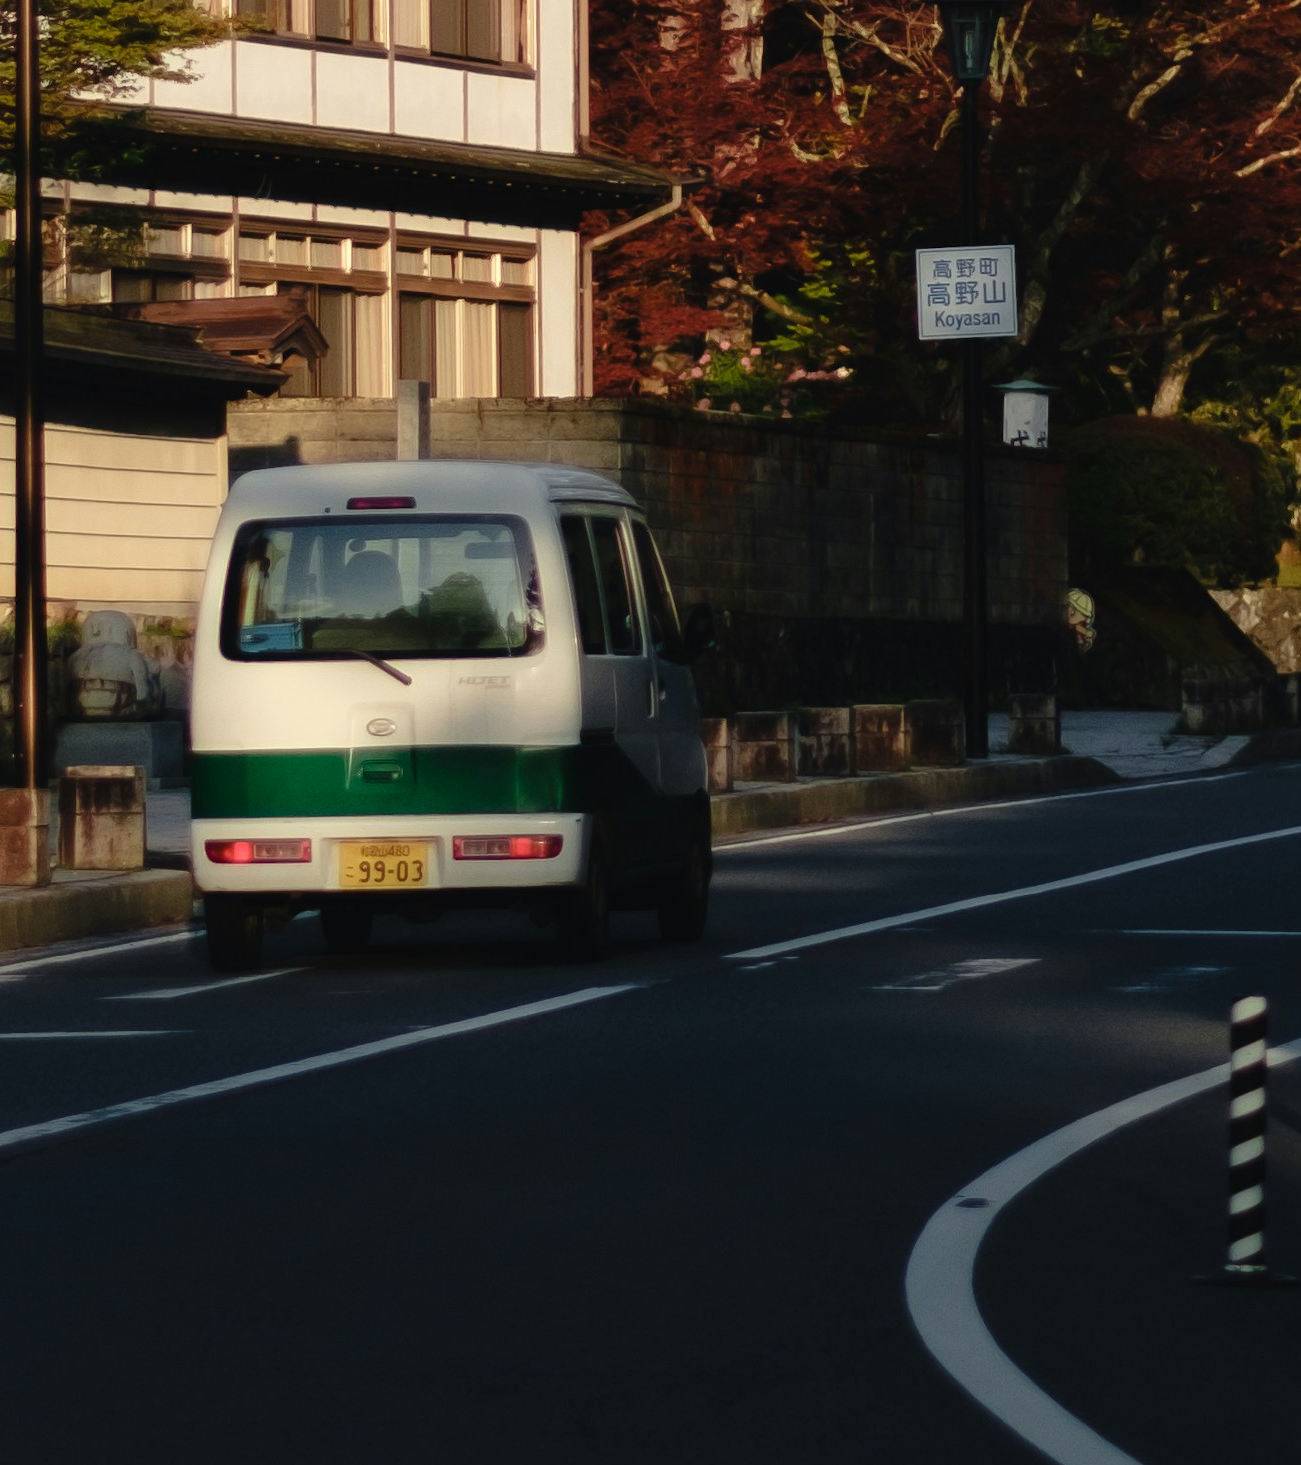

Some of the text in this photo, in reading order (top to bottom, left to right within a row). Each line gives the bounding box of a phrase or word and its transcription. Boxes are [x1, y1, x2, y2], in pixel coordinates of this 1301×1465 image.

[933, 258, 998, 278] 高野町
[927, 280, 1006, 307] 高野山
[935, 311, 1000, 330] Koyasan
[359, 860, 423, 883] 99-03
